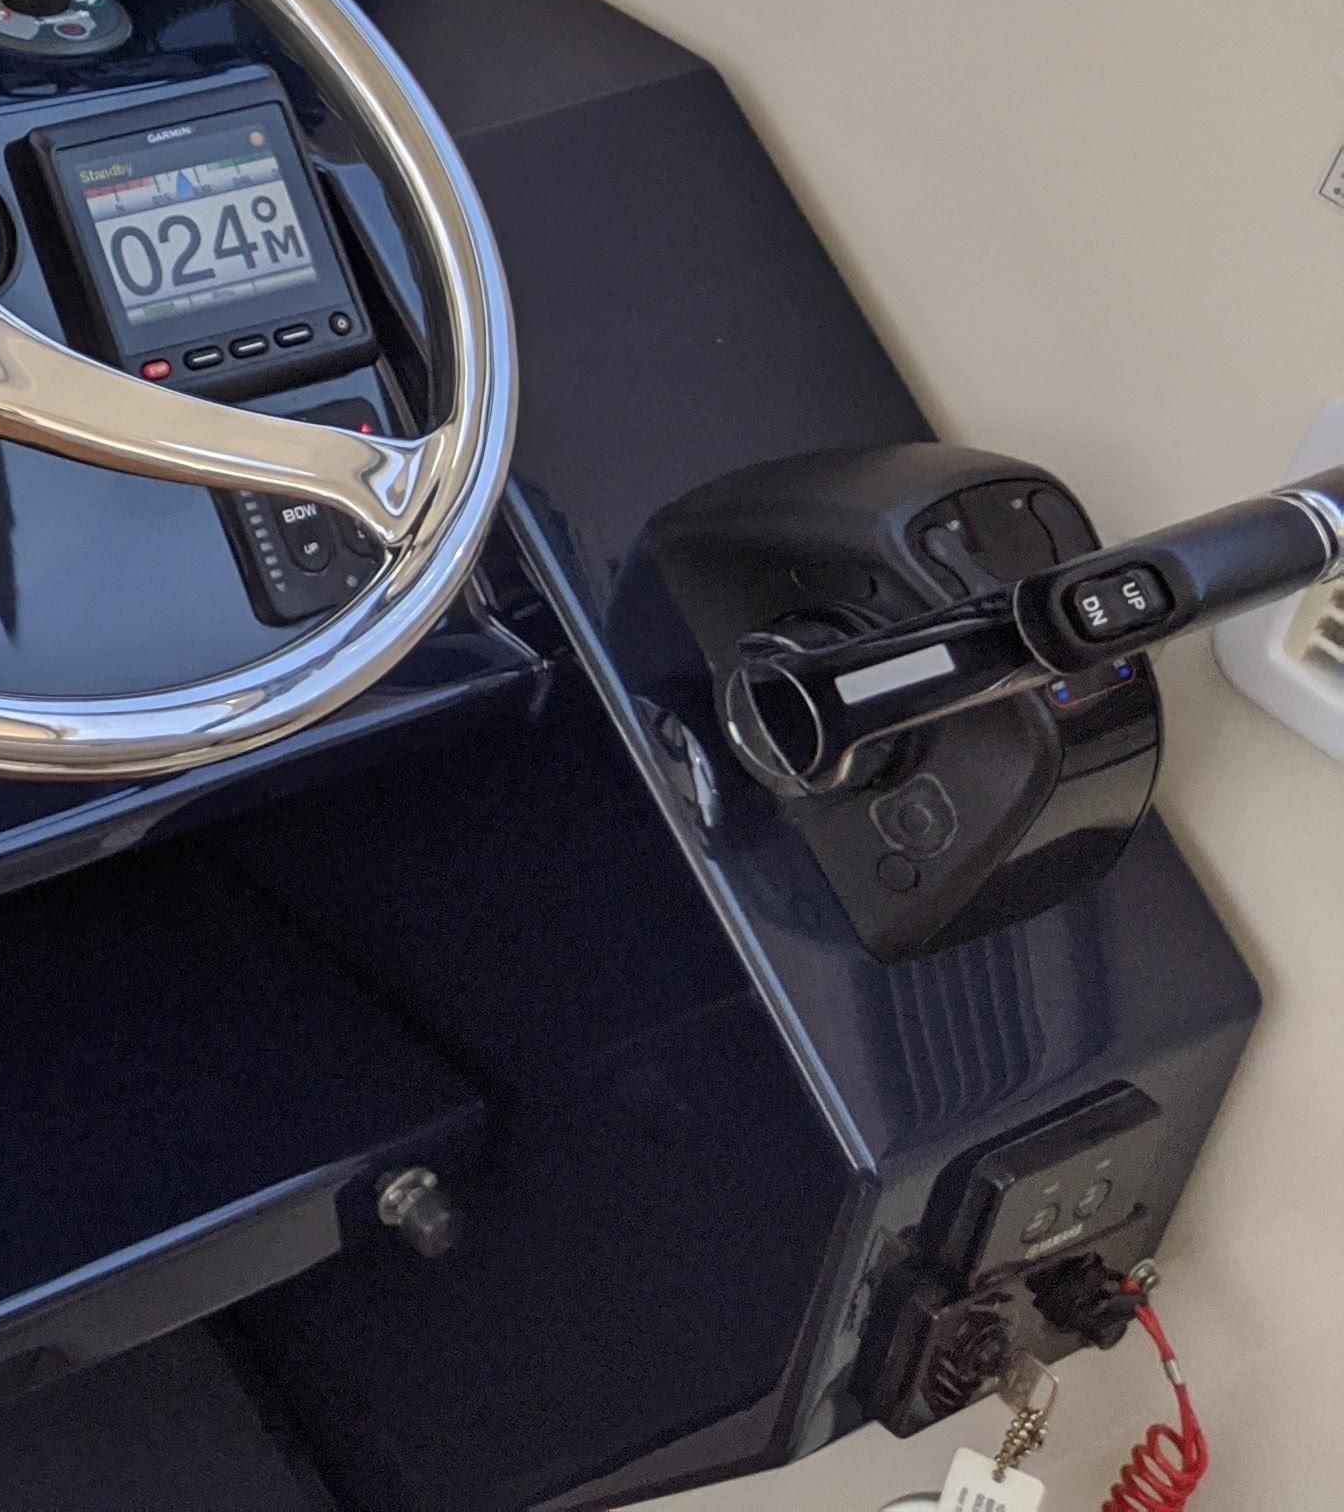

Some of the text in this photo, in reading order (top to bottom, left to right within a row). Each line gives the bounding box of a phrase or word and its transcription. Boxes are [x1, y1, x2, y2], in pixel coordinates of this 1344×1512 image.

[146, 125, 193, 144] GARMIN
[79, 163, 134, 184] Standby
[282, 503, 318, 524] BOW
[303, 541, 320, 556] UP
[1123, 581, 1146, 611] UP
[1081, 594, 1108, 627] DN
